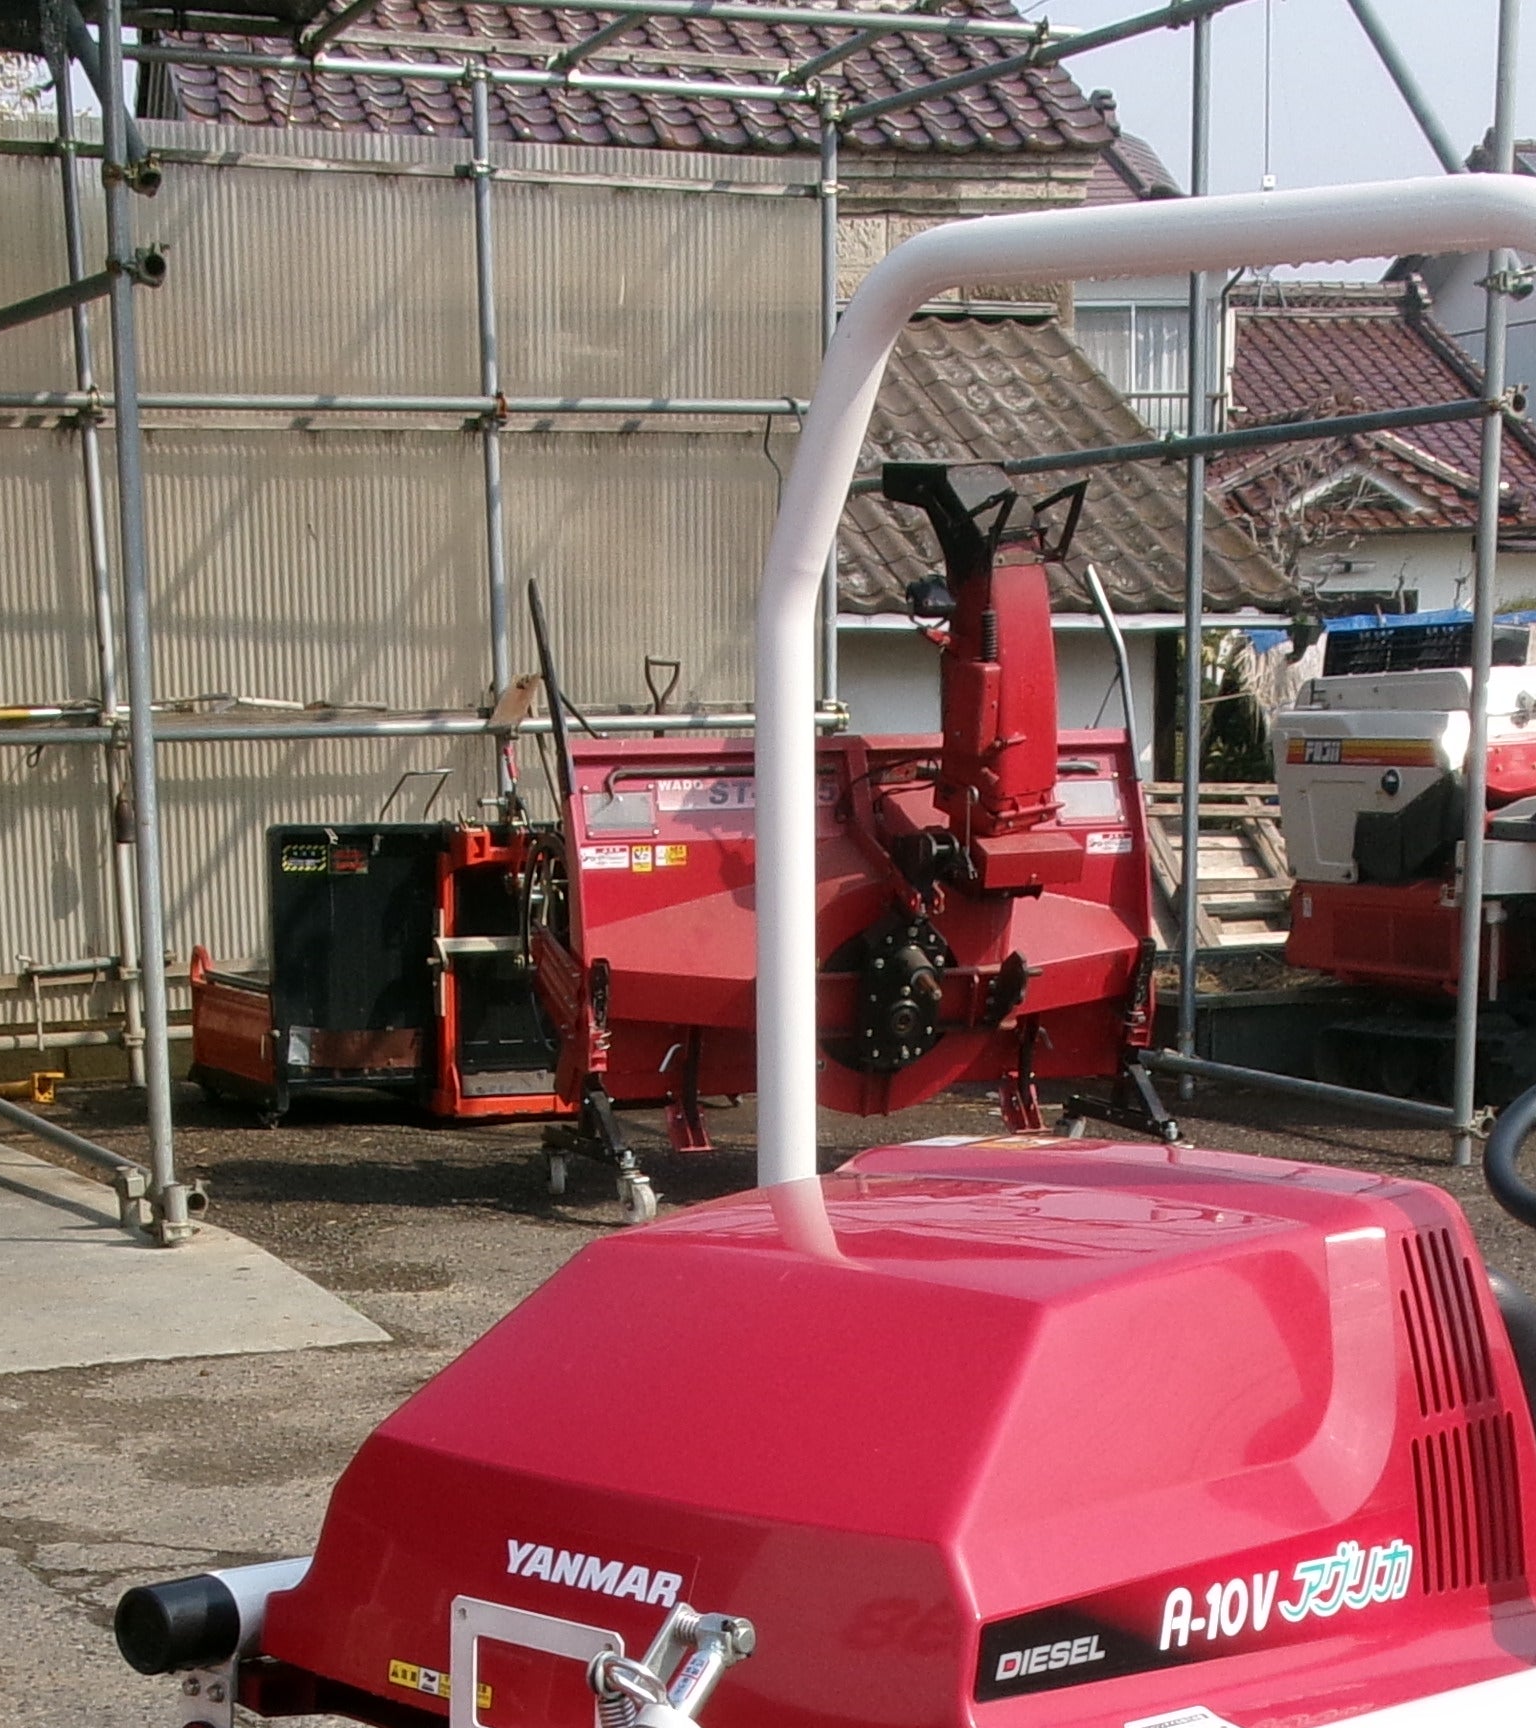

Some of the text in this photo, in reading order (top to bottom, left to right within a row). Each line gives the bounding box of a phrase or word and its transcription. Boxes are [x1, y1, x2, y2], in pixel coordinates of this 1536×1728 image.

[658, 779, 704, 792] WADO
[506, 1538, 683, 1609] YANMAR
[1159, 1537, 1414, 1652] A-10V アグリカ
[994, 1634, 1107, 1682] DIESEL
